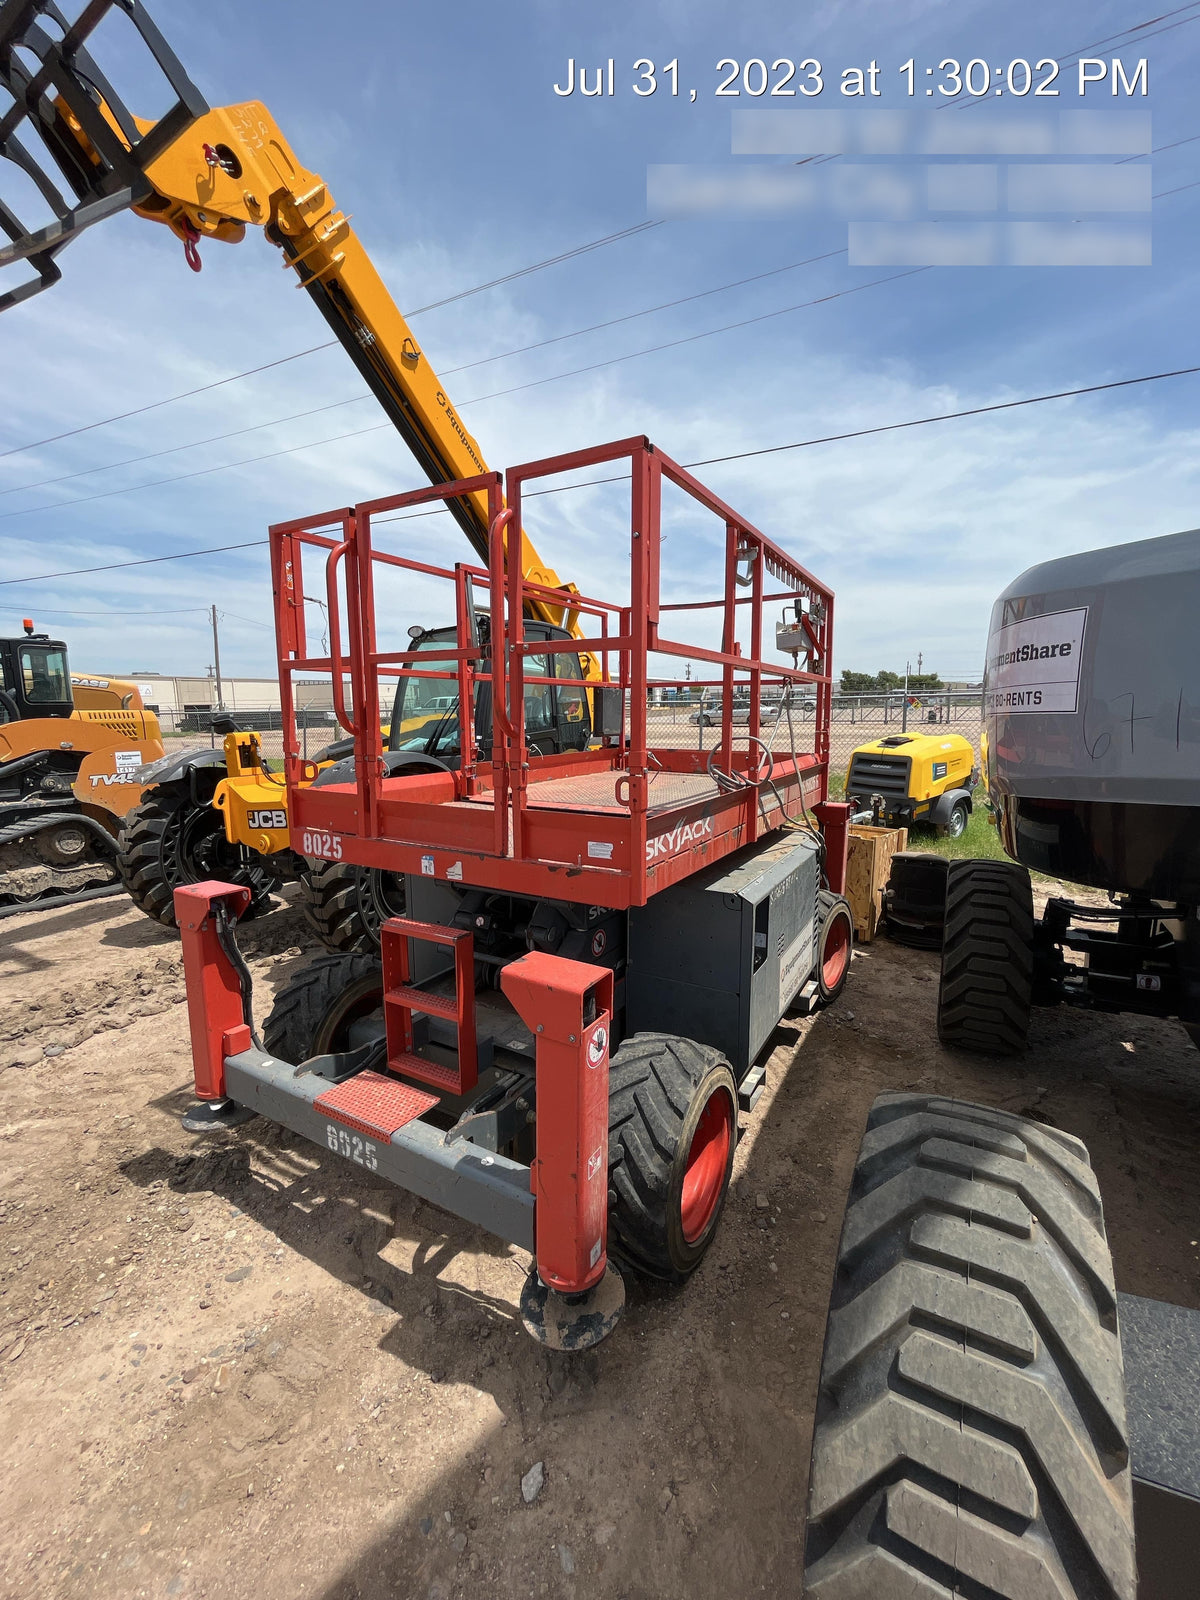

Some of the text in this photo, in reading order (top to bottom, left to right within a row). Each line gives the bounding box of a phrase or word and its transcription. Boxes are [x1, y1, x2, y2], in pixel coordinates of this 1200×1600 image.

[71, 678, 109, 689] CASE
[248, 810, 287, 829] JCB
[303, 832, 343, 859] 8025
[646, 816, 712, 861] SKYJACK
